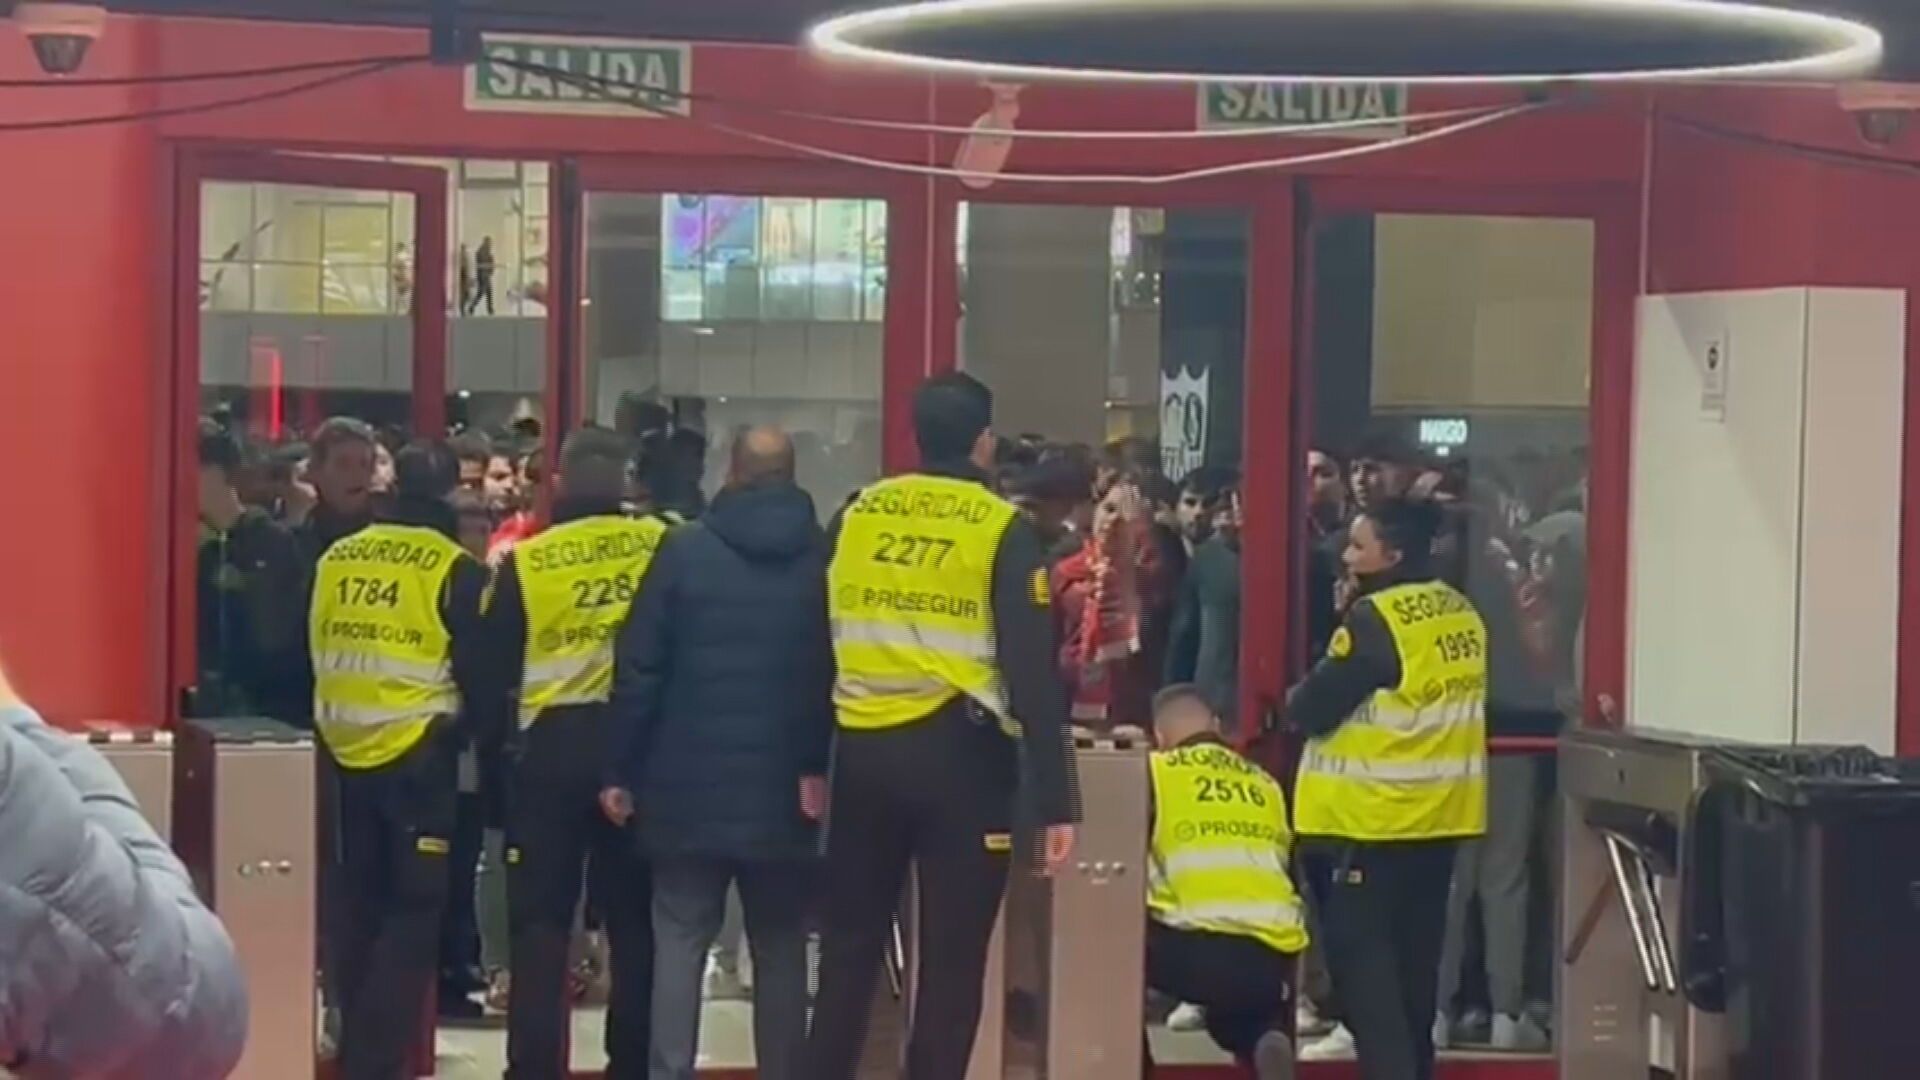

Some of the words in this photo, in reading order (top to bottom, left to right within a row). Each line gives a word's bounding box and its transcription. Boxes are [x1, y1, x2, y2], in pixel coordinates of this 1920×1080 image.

[487, 46, 673, 102] SALIDA
[1219, 80, 1388, 119] SALIDA
[854, 489, 992, 524] SEGURIDAD
[873, 532, 955, 569] 2277
[336, 576, 399, 608] 1784
[571, 572, 633, 608] 228
[863, 587, 979, 621] PROSEGUR
[1434, 630, 1481, 664] 1995
[1194, 775, 1266, 808] 2516
